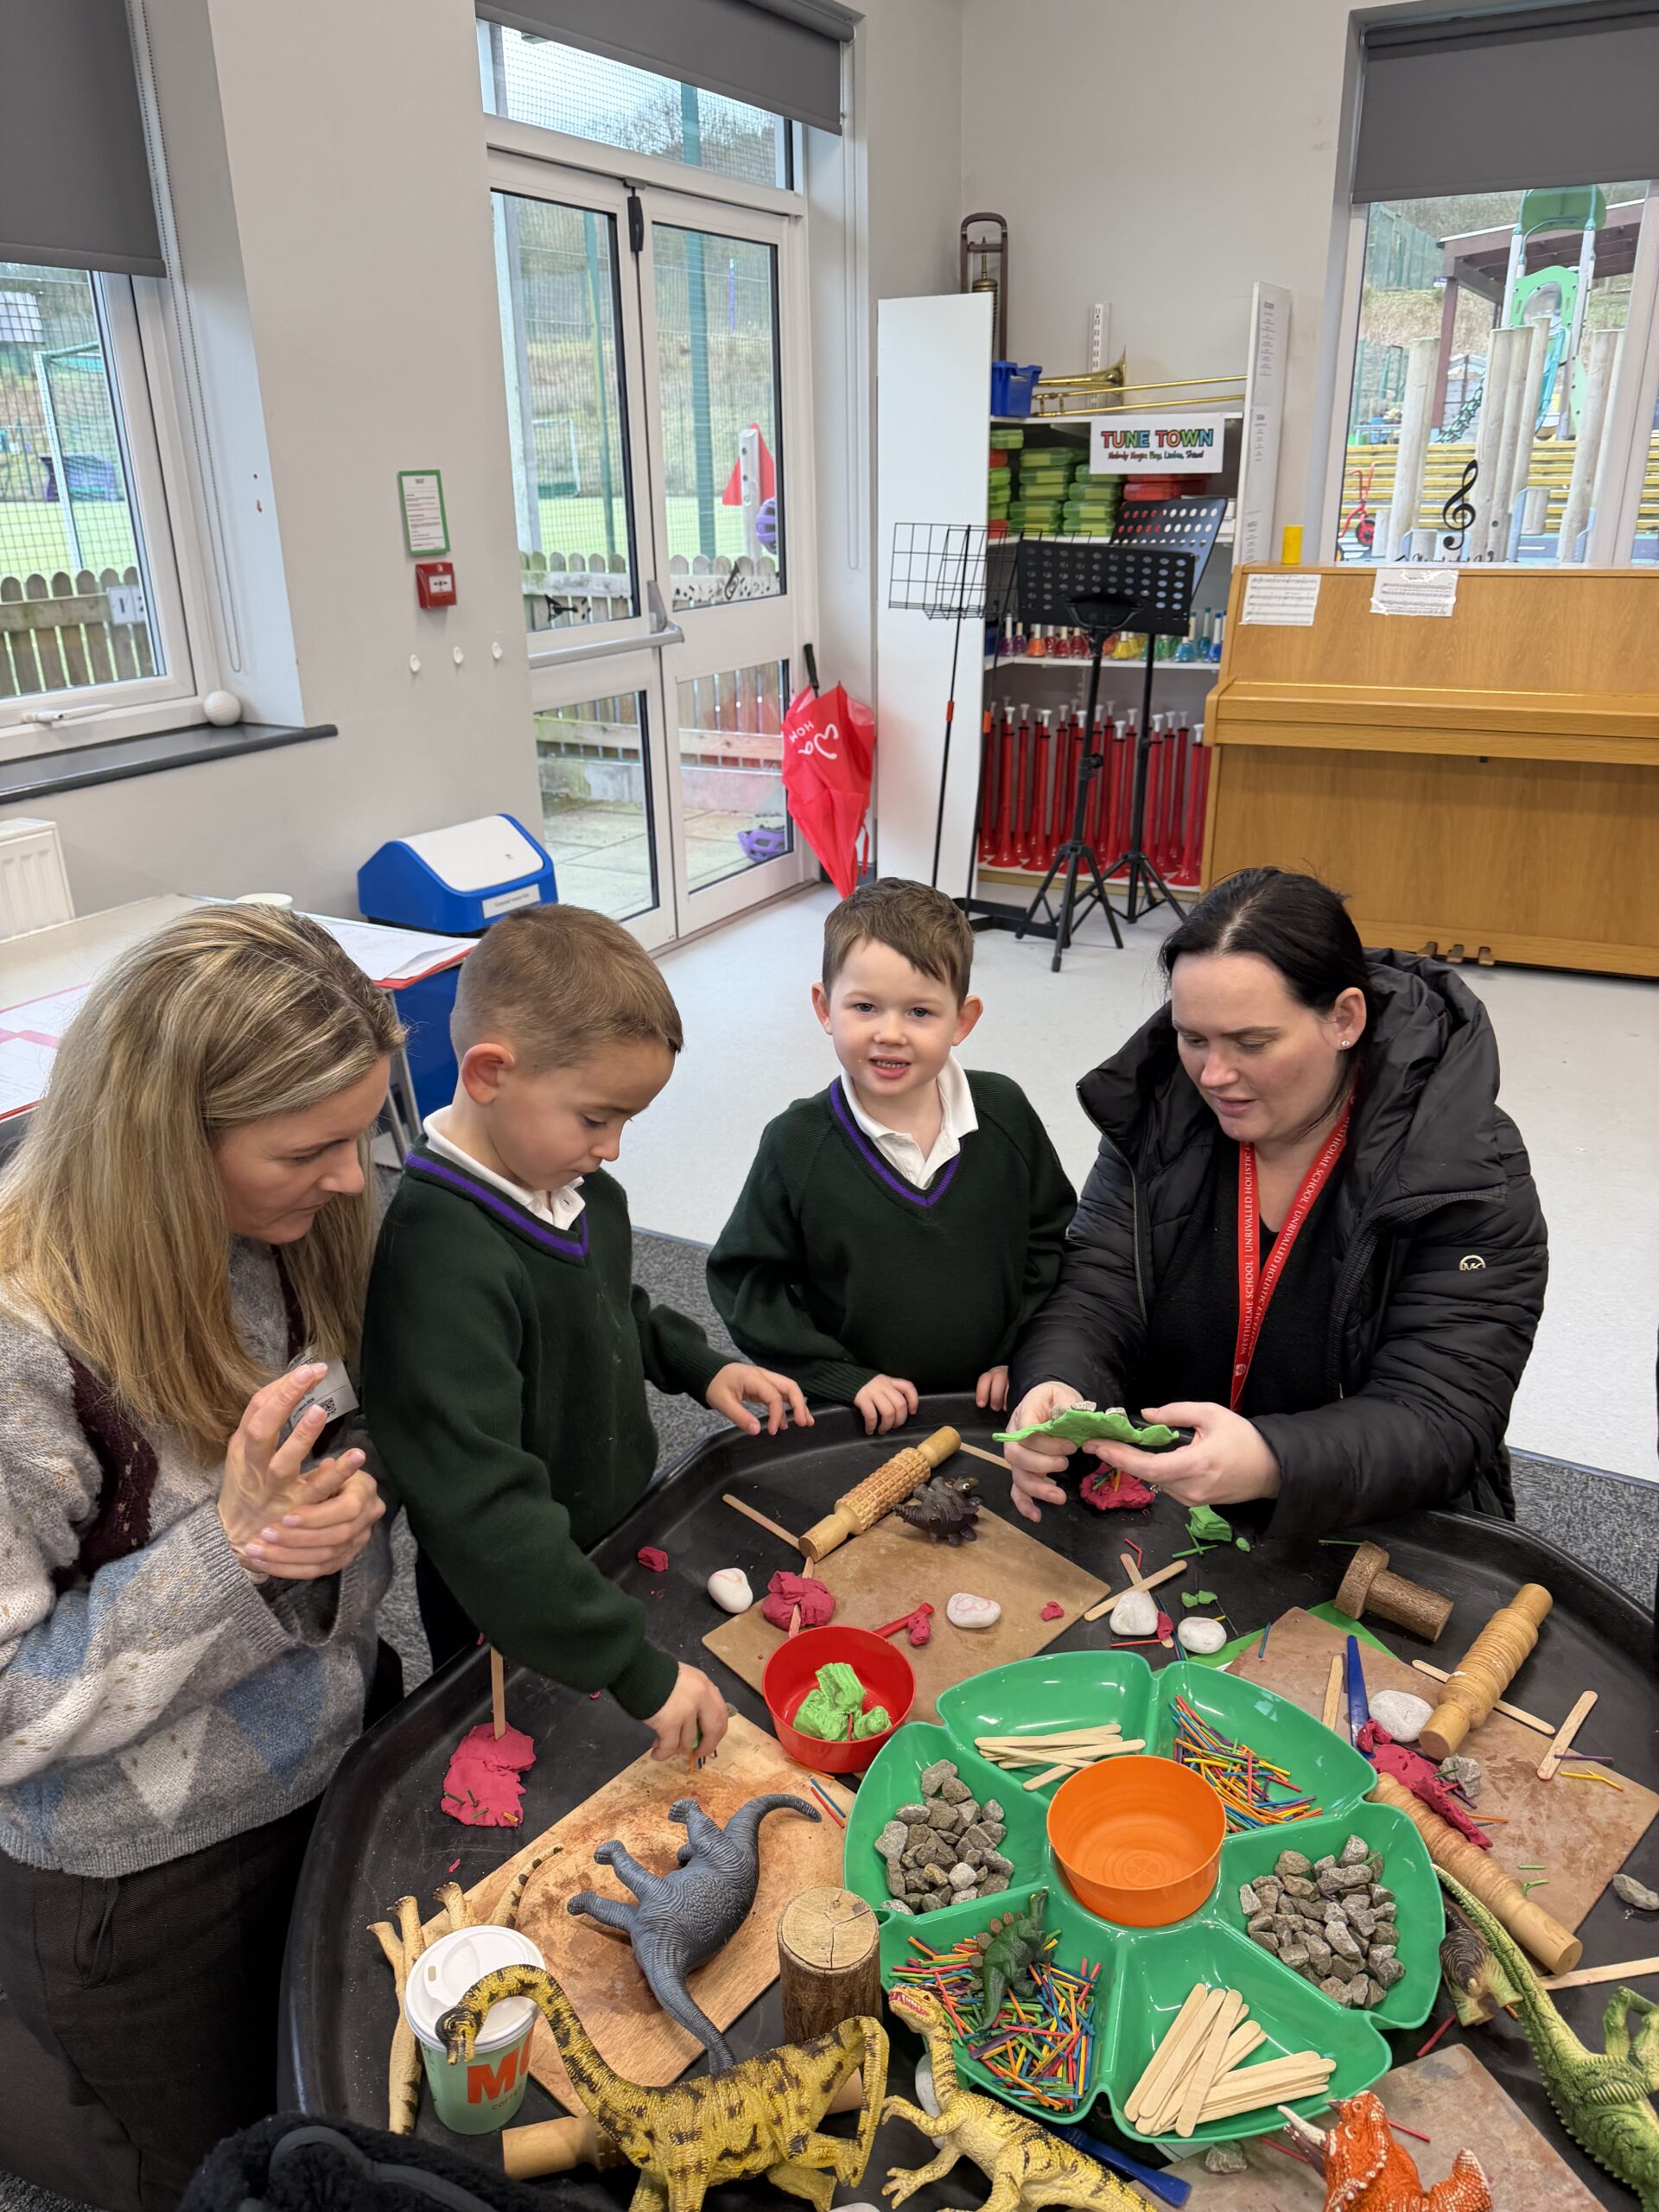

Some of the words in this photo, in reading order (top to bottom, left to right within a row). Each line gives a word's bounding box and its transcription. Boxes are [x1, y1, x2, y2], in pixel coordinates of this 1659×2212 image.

[1101, 430, 1150, 448] TUNE
[1155, 429, 1214, 448] TOWN
[1300, 1168, 1324, 1203] SCHOOL
[1244, 1196, 1254, 1252] UNRIVALLED
[1273, 1211, 1303, 1263] UNRIVALLED
[1244, 1261, 1254, 1299] SCHOOL
